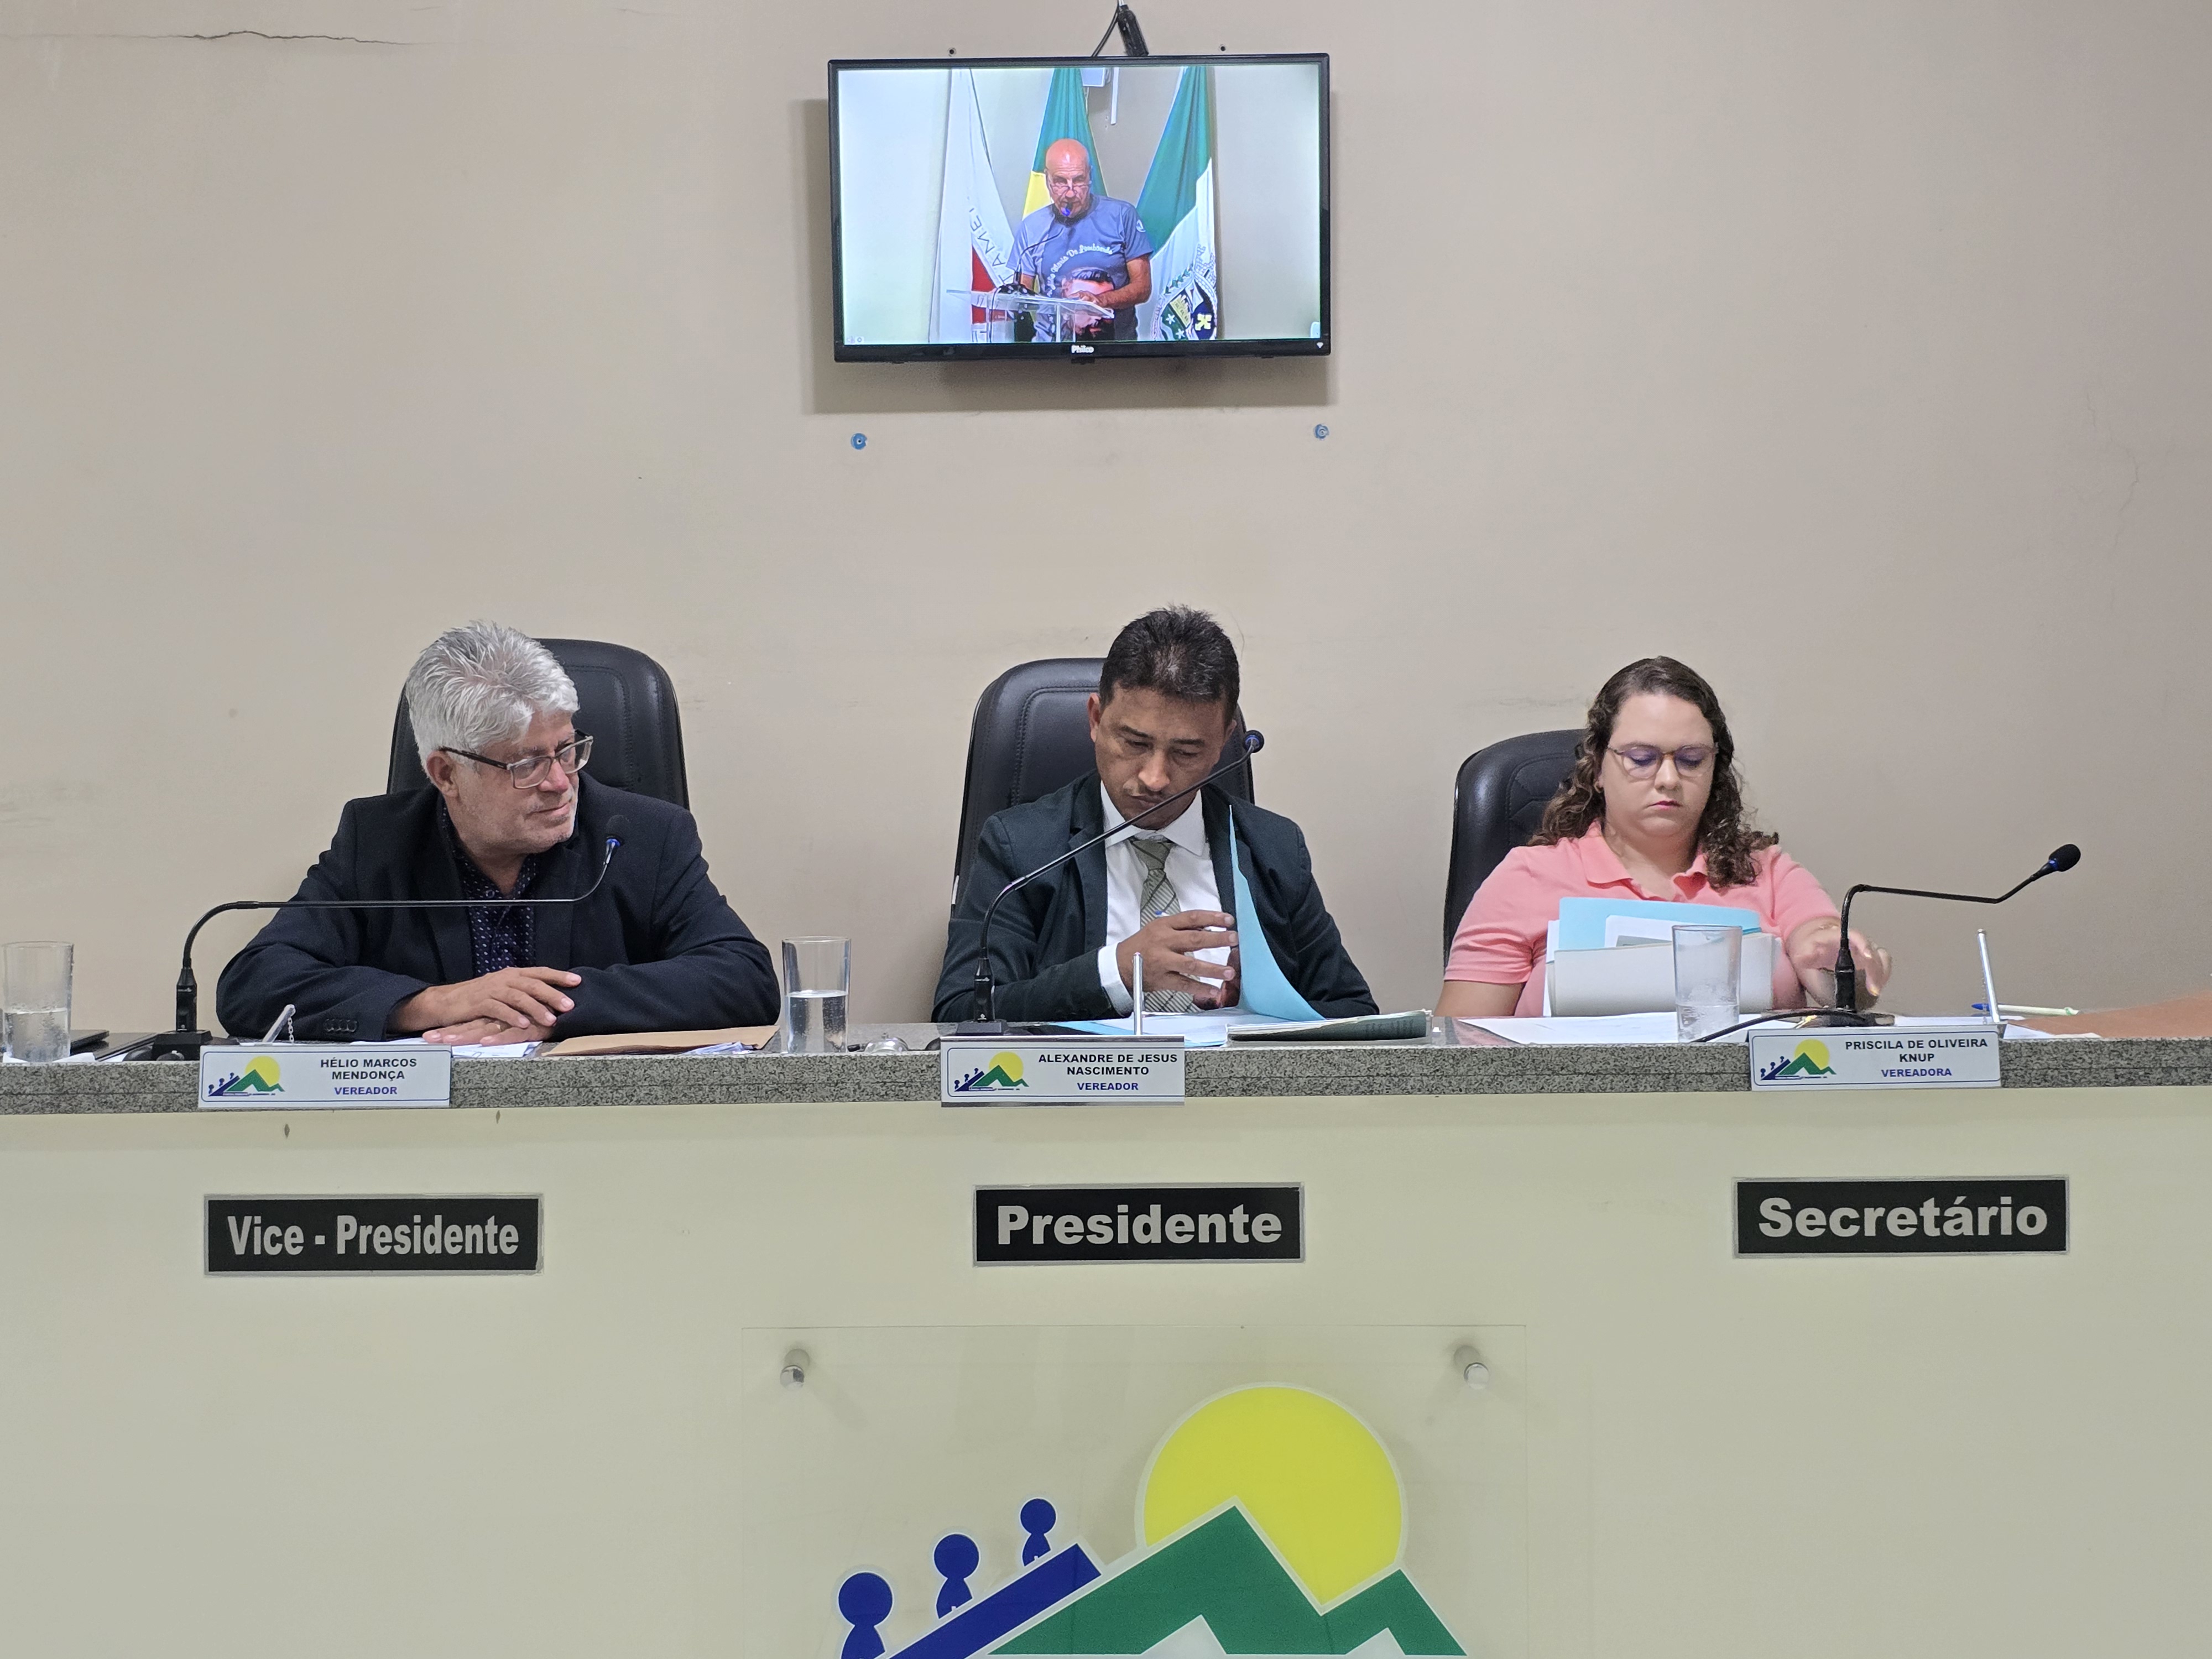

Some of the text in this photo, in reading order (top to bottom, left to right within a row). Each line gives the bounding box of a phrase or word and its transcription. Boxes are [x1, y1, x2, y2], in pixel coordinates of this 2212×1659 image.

[969, 208, 1014, 285] TAME
[1071, 345, 1094, 353] Philco
[1845, 1039, 1988, 1050] PRISCILA DE OLIVEIRA
[320, 1057, 417, 1068] HÉLIO MARCOS
[1038, 1054, 1177, 1063] ALEXANDRE DE JESUS
[1899, 1053, 1935, 1062] KNUP
[1067, 1066, 1149, 1075] NASCIMENTO
[1880, 1068, 1952, 1078] VEREADORA
[331, 1071, 405, 1082] MENDONÇA
[334, 1086, 398, 1095] VEREADOR
[1077, 1082, 1139, 1091] VEREADOR
[1759, 1196, 2048, 1238] Secretário
[998, 1204, 1282, 1245] Presidente
[227, 1215, 304, 1255] Vice
[337, 1214, 519, 1255] Presidente
